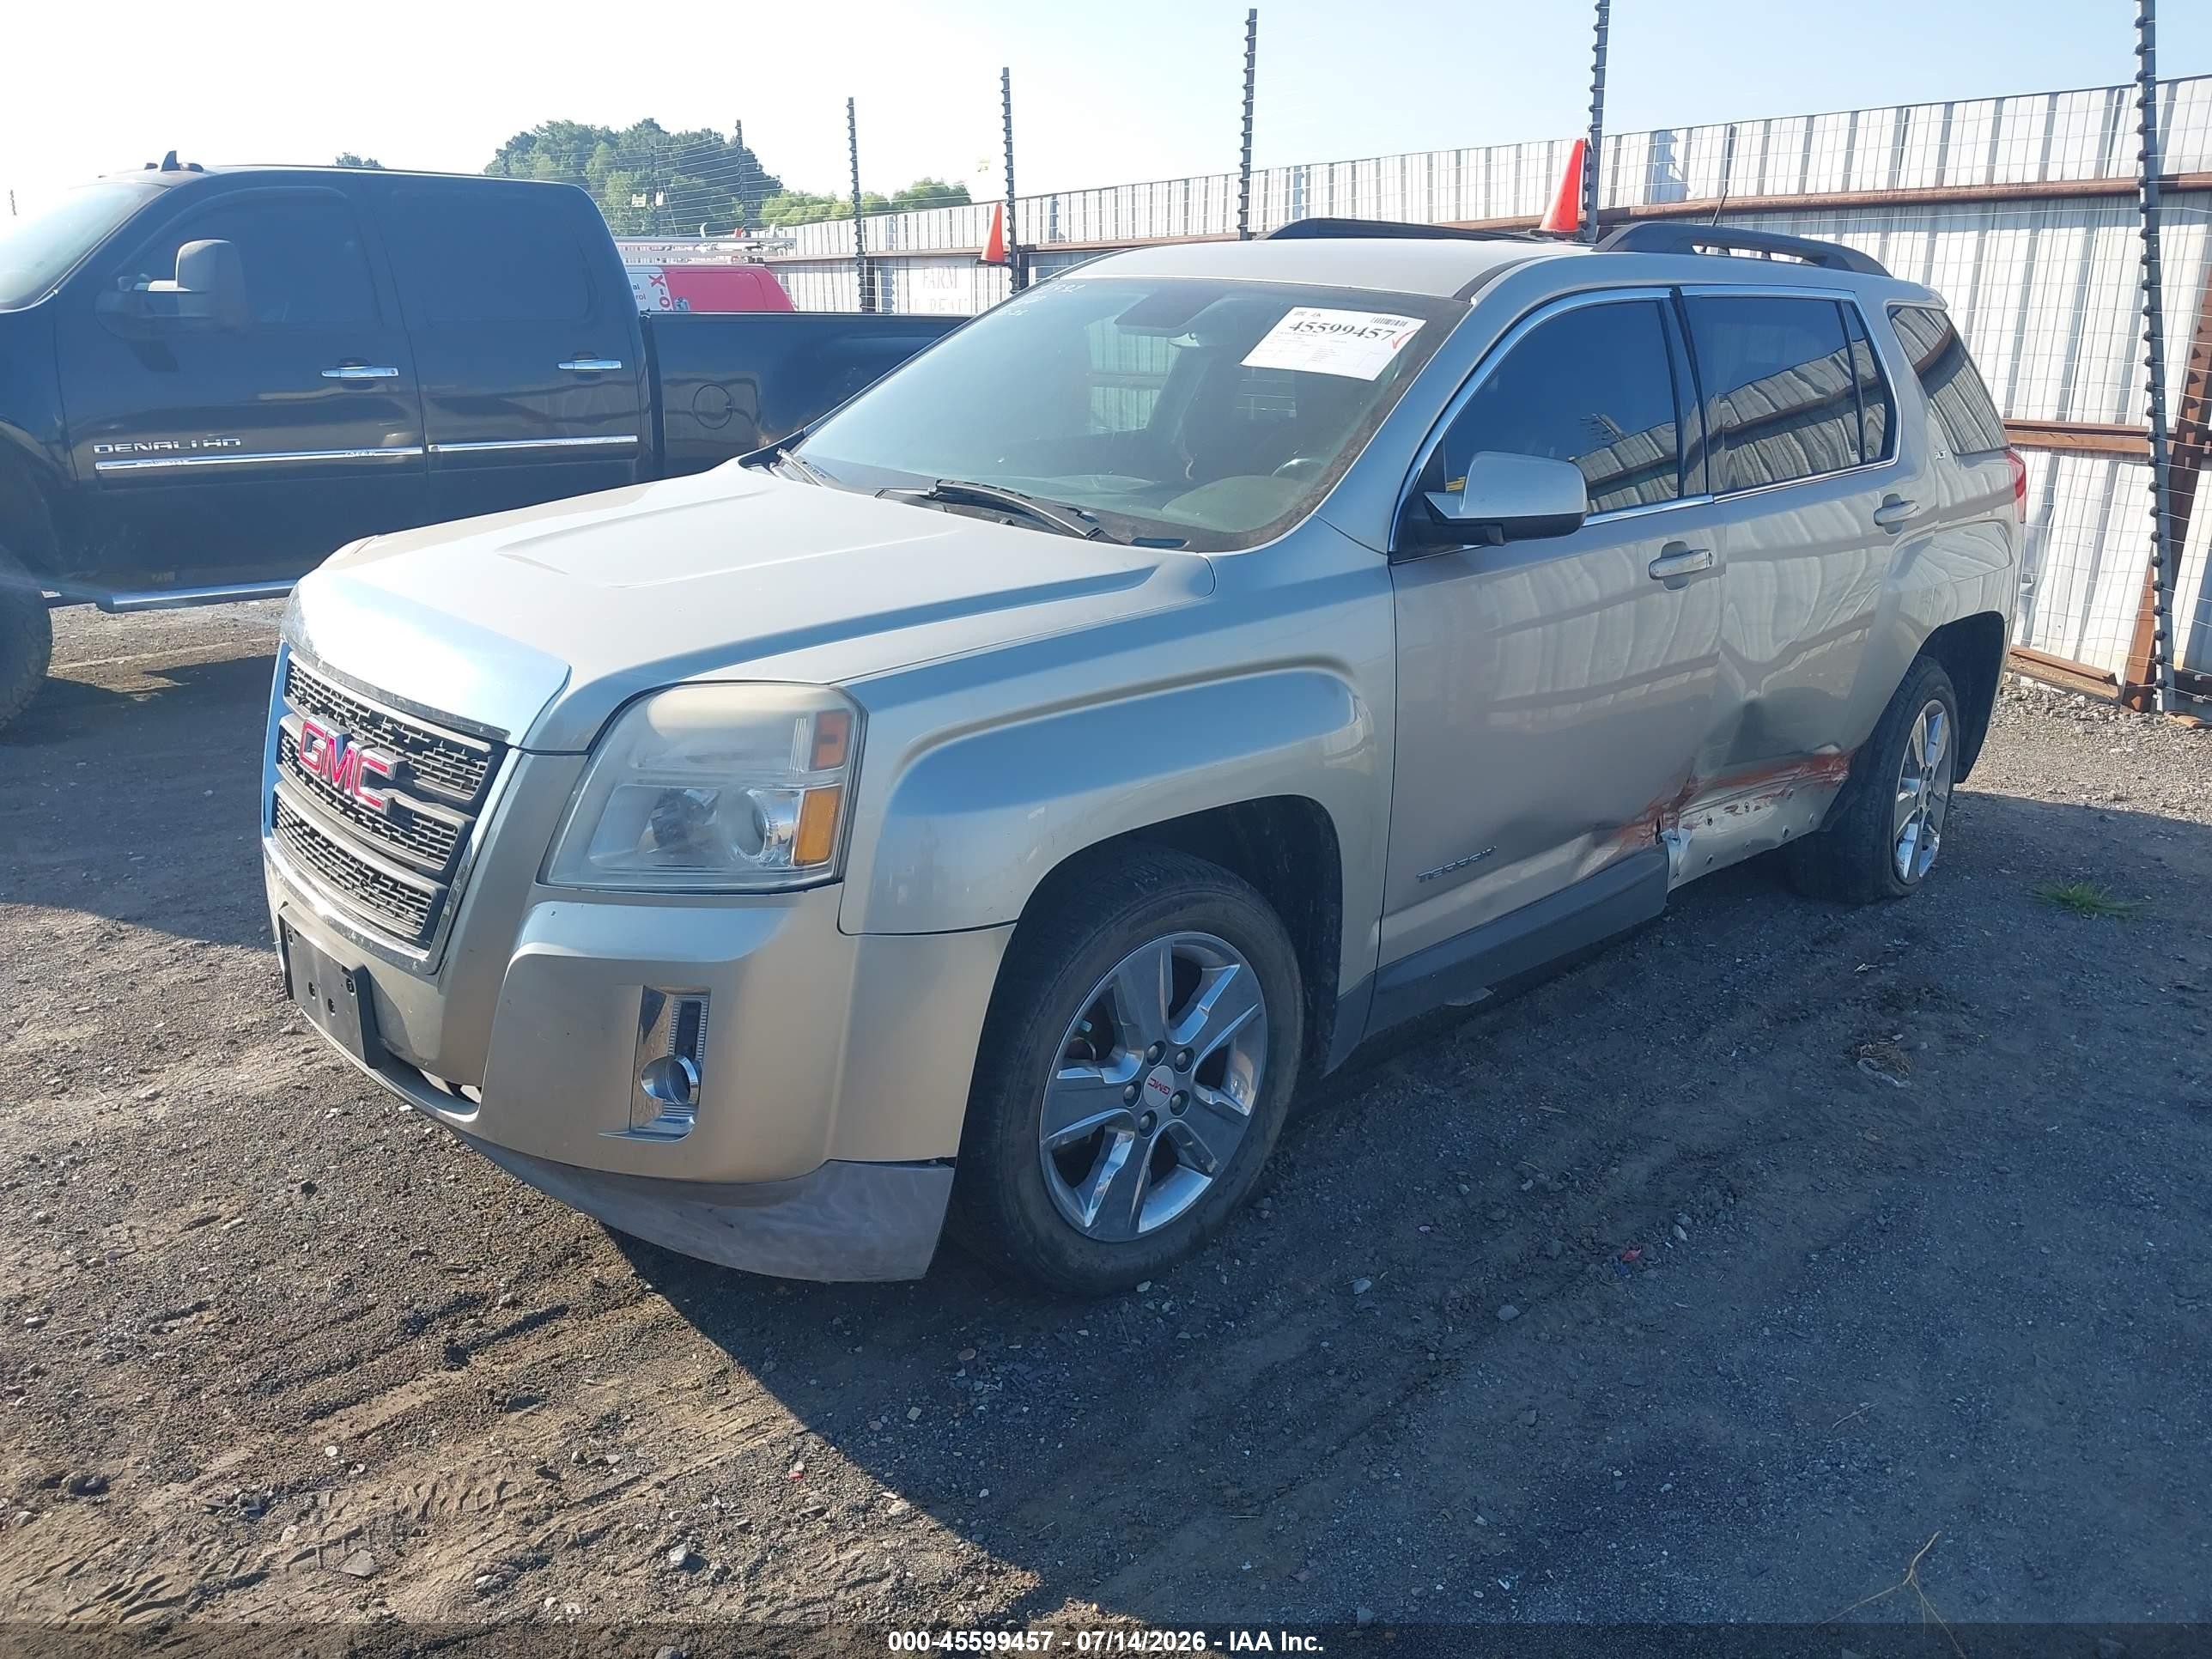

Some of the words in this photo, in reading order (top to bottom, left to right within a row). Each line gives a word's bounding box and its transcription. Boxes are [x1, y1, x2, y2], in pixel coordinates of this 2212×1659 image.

[1288, 320, 1396, 341] 45599457
[94, 440, 197, 453] DENALI
[203, 438, 241, 447] HD
[299, 719, 397, 816] GMC
[1148, 1077, 1171, 1096] GMC
